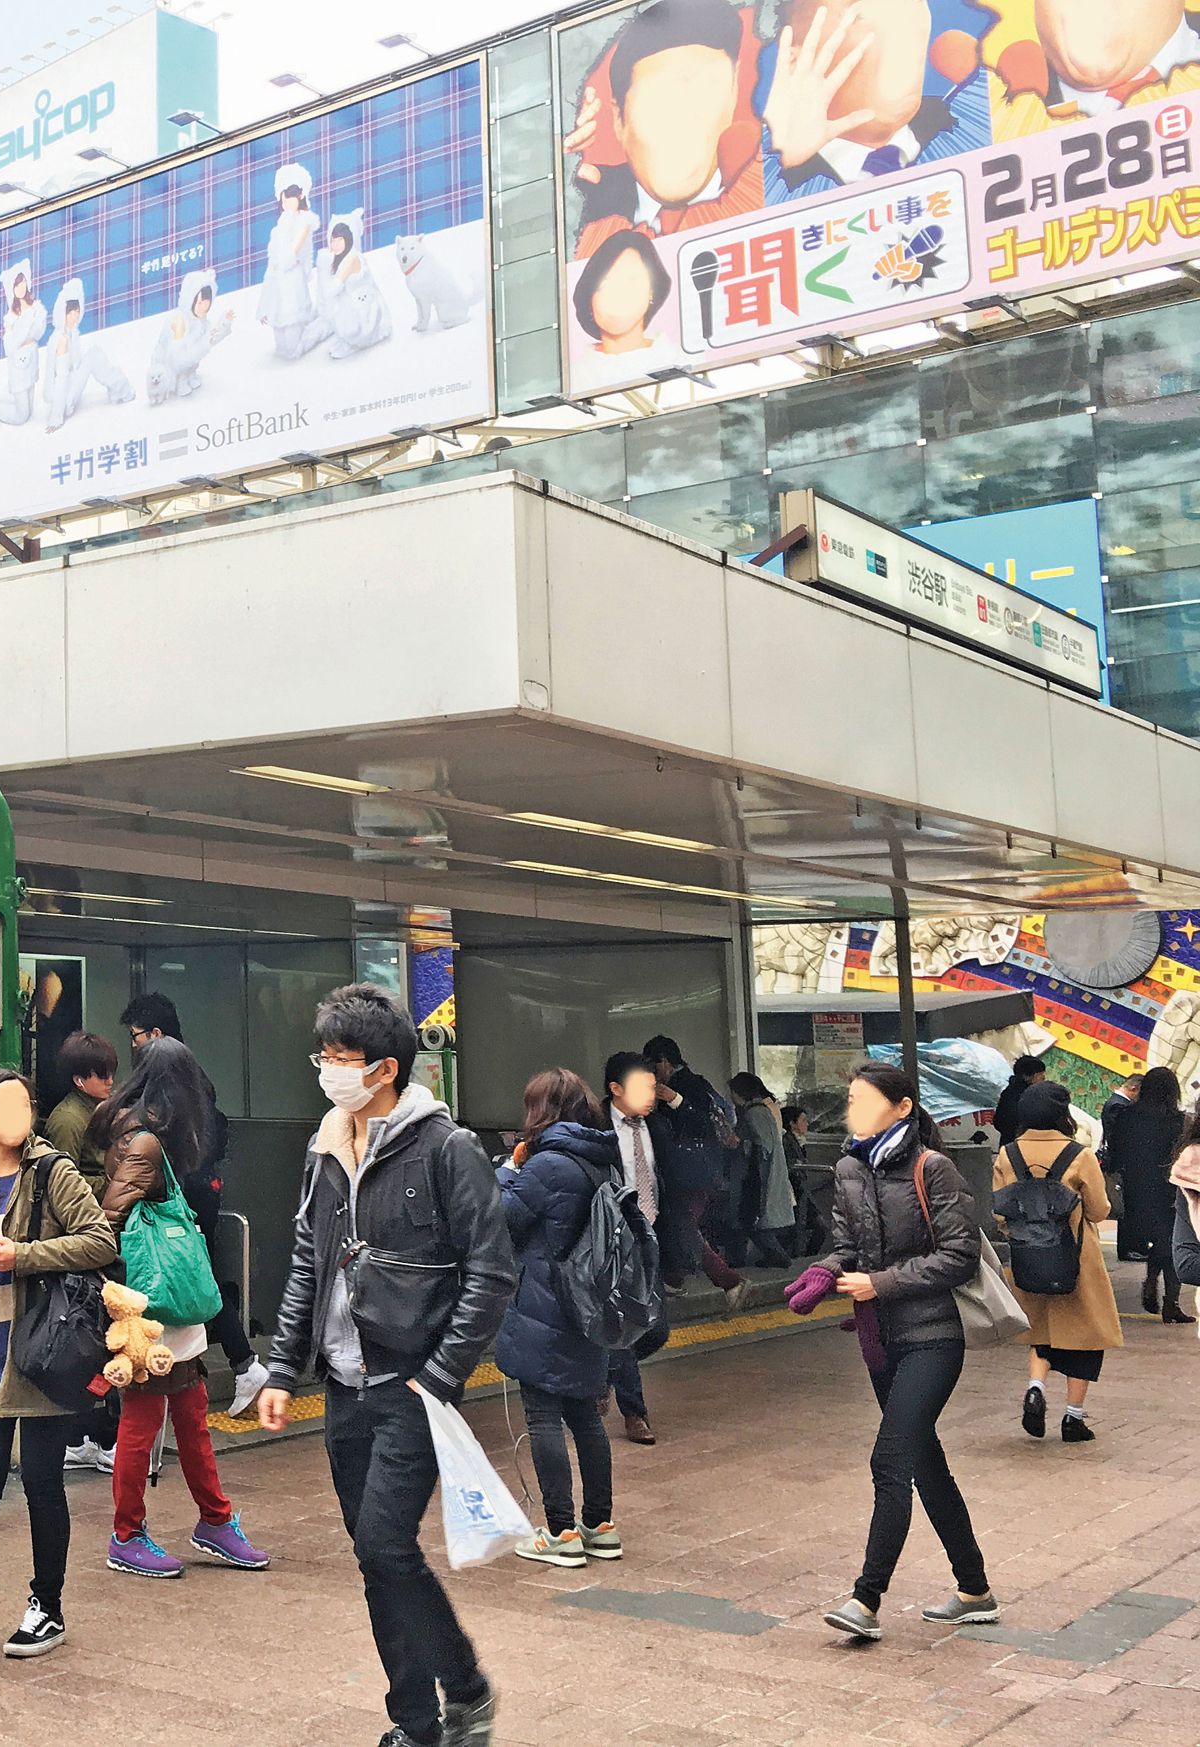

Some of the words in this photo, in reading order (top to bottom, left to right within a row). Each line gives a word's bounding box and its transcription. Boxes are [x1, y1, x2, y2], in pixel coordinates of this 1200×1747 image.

[981, 120, 1193, 223] 2月28日
[802, 190, 953, 252] きにくい事を
[714, 226, 855, 327] 聞く
[50, 436, 149, 485] ギガ学割
[195, 402, 311, 453] SoftBank
